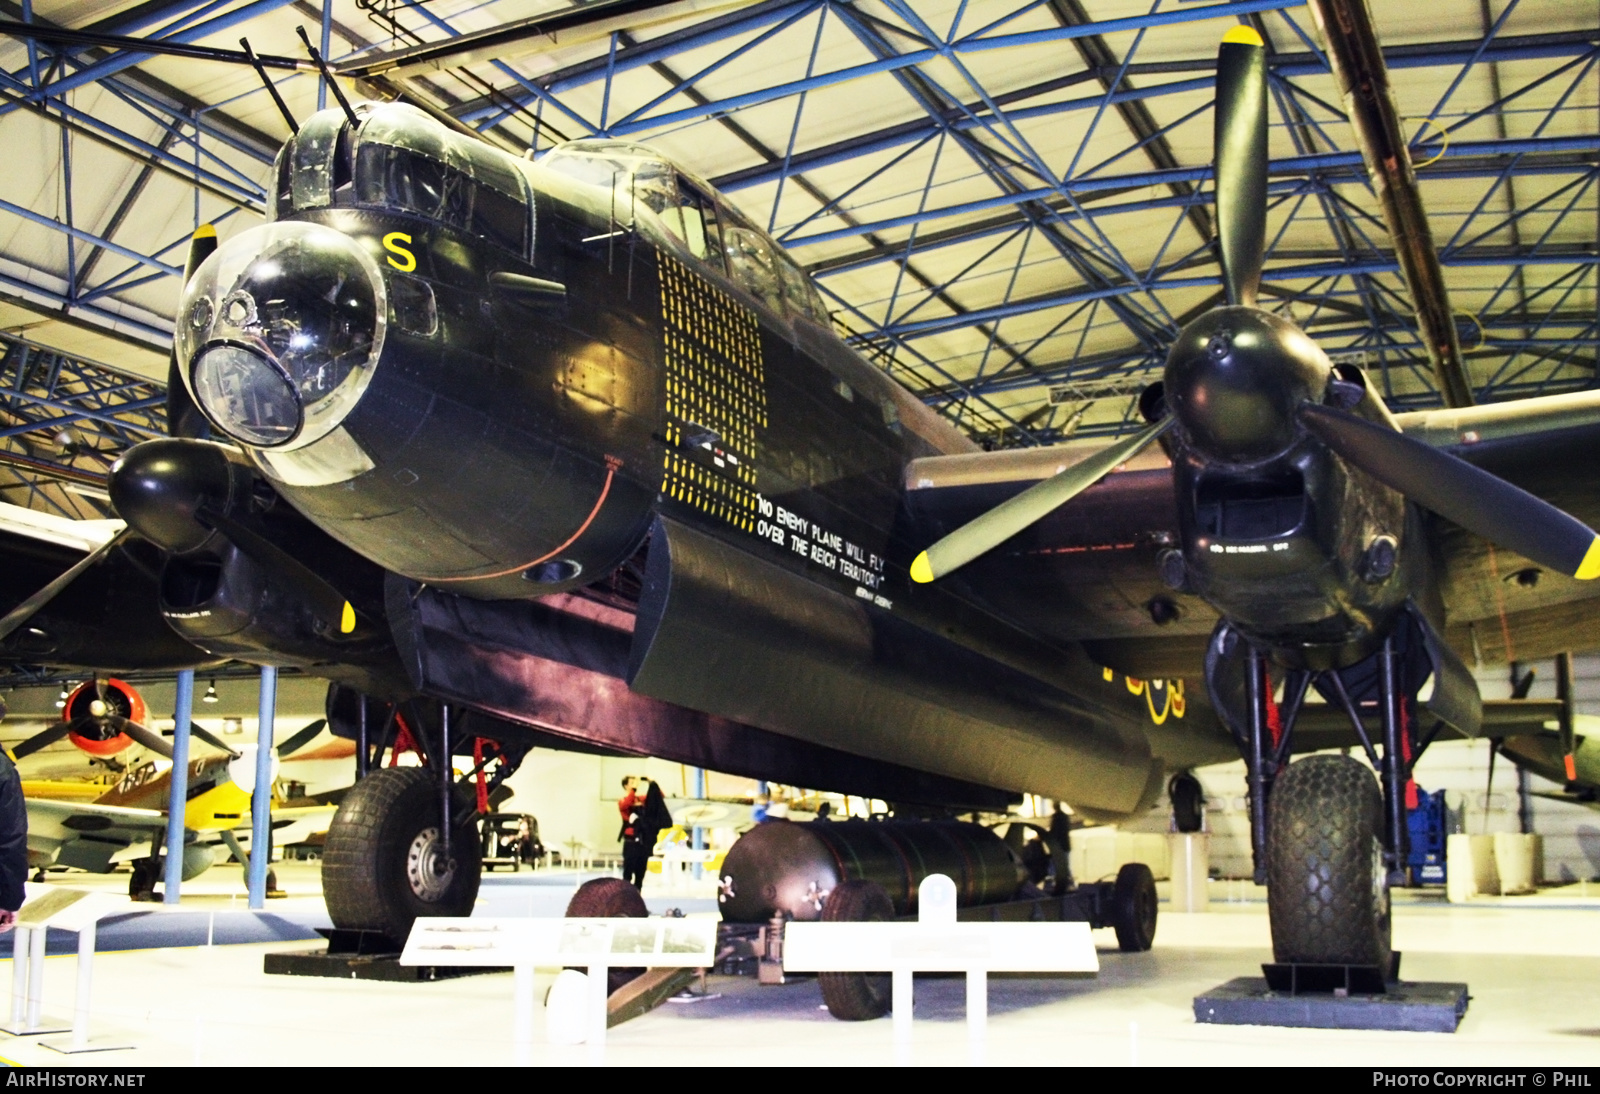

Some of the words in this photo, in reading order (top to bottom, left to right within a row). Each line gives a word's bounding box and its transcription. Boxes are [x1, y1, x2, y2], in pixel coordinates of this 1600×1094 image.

[382, 231, 417, 272] S
[757, 519, 785, 546] OVER
[791, 534, 808, 556] THE
[810, 544, 837, 570] REICH
[776, 506, 808, 535] ENEMY
[811, 524, 842, 553] PLANE
[845, 541, 866, 564] WILL
[869, 553, 885, 572] FLY
